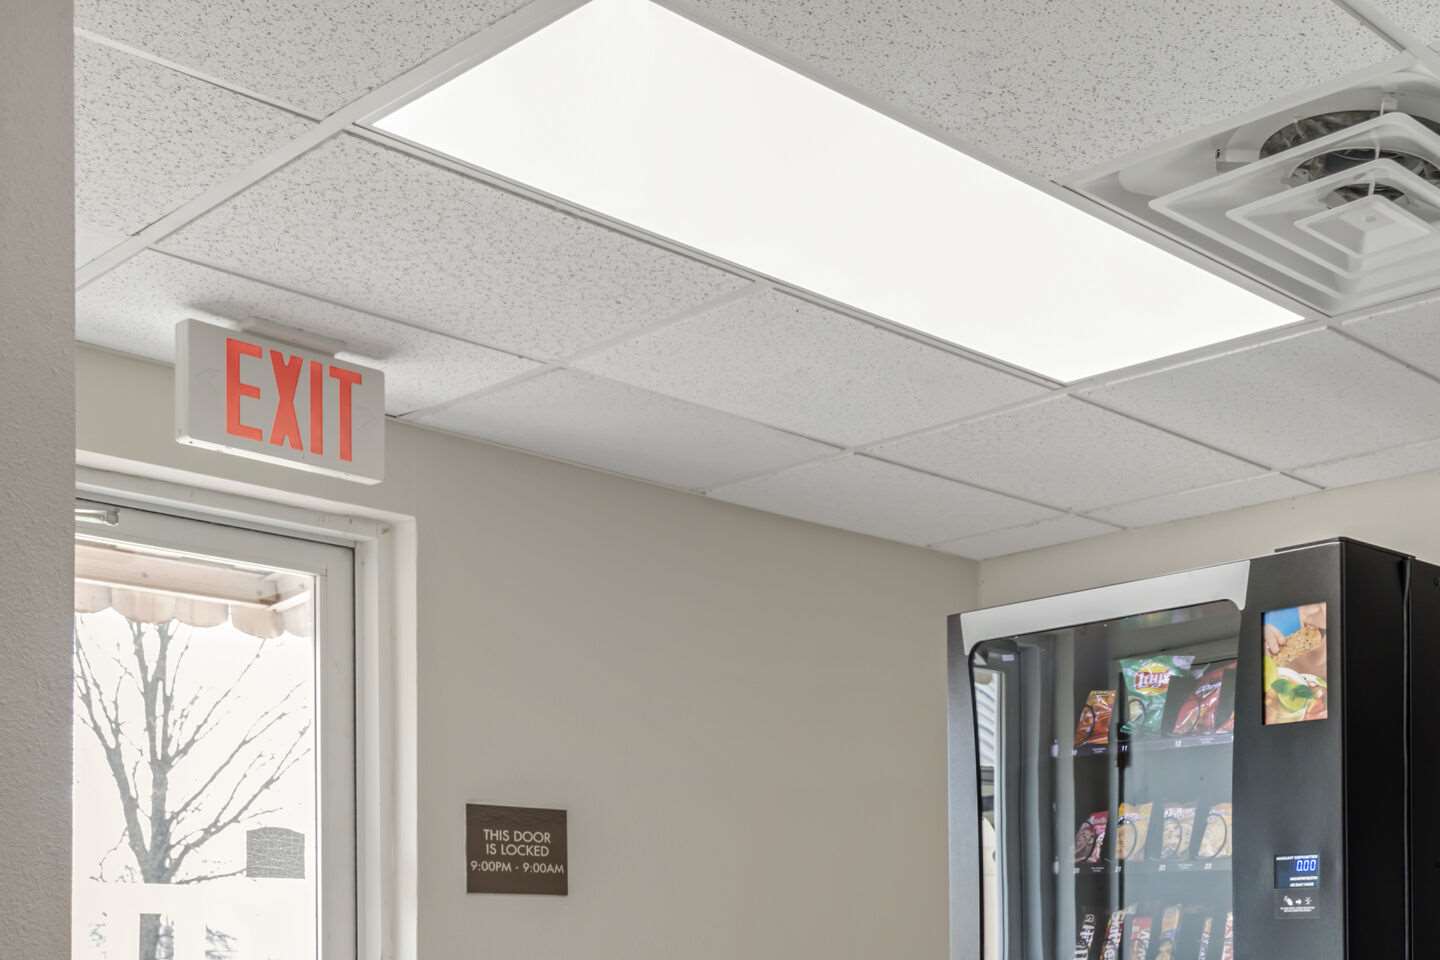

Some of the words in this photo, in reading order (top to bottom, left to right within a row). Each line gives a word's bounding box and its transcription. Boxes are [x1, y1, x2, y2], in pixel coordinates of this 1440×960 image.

[226, 337, 362, 462] EXIT
[483, 829, 510, 842] THIS
[513, 830, 551, 844] DOOR
[486, 843, 497, 855] IS
[501, 844, 550, 857] LOCKED
[470, 860, 512, 872] 9:00PM
[522, 862, 565, 874] 9:00AM
